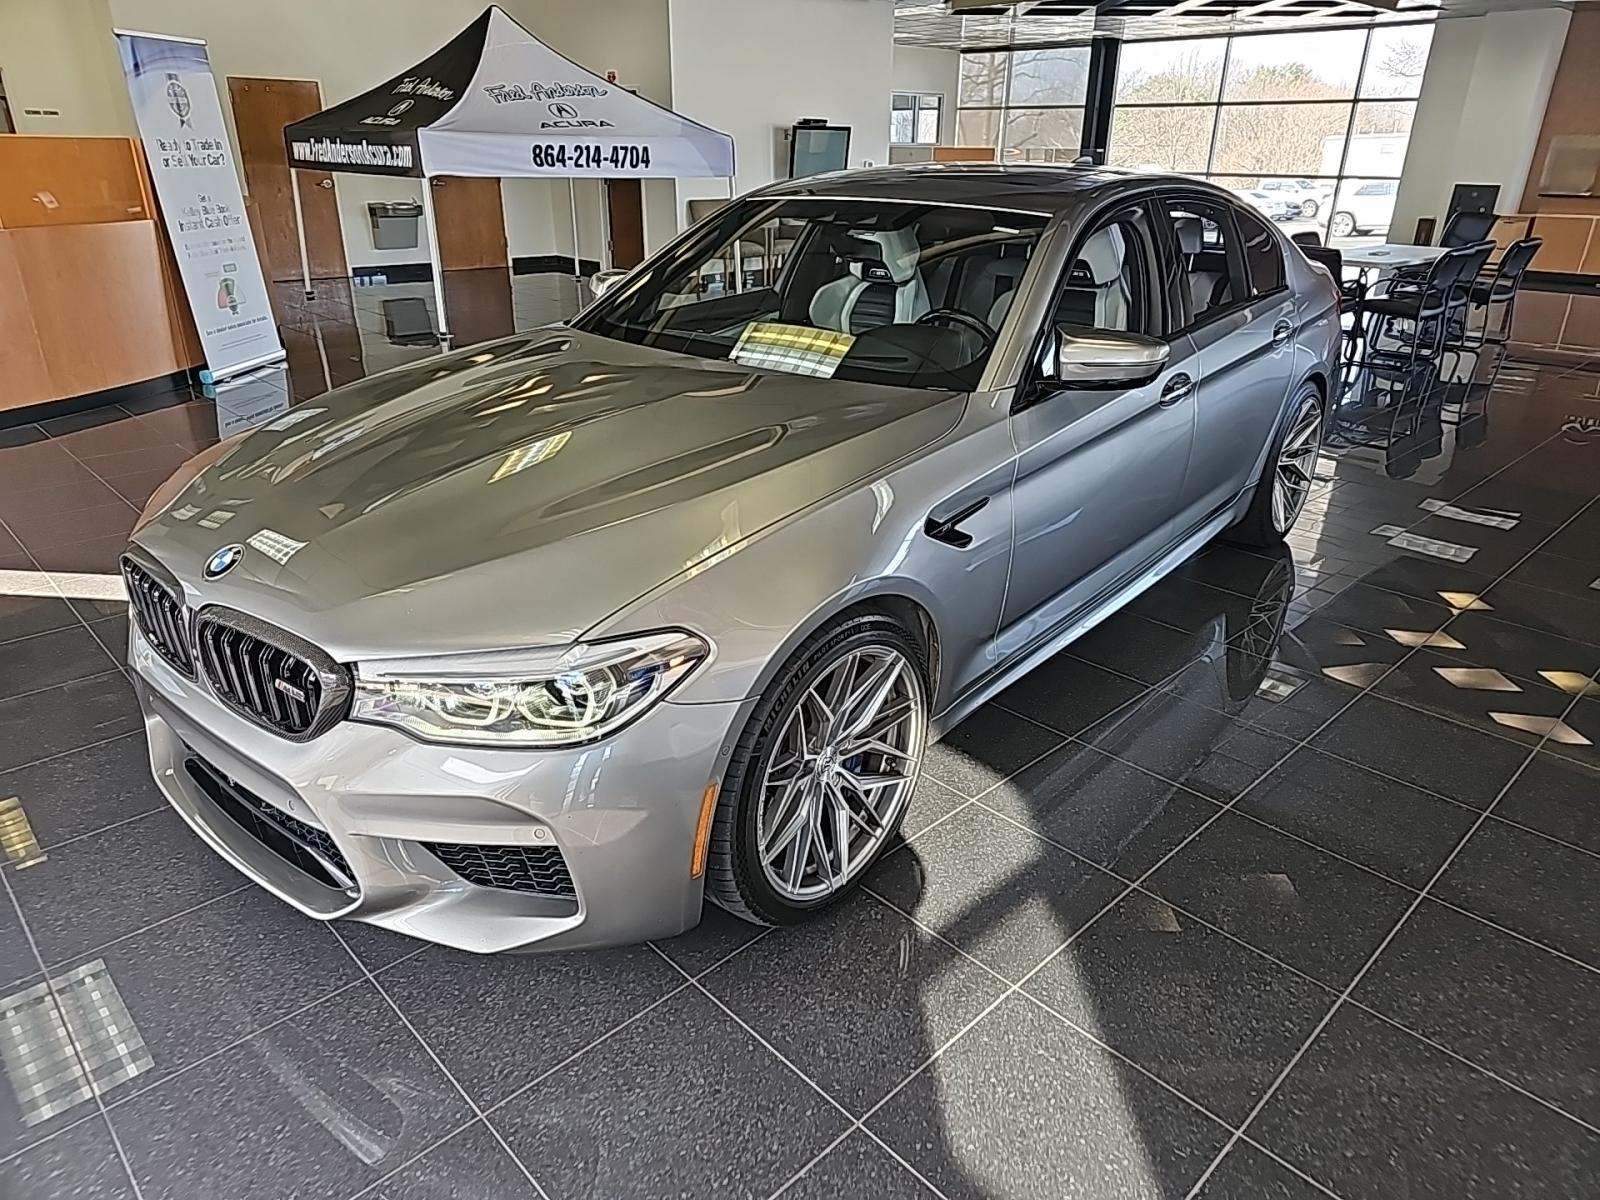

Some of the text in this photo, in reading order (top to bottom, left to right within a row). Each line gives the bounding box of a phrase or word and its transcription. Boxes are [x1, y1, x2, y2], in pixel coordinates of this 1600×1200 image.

[484, 82, 608, 104] Fred Anderson
[359, 116, 402, 126] ACURA
[540, 120, 615, 129] ACURA
[292, 137, 413, 168] www.FredAndersonAcura.com
[532, 144, 650, 169] 864-214-4704
[763, 660, 811, 732] MICHELIN
